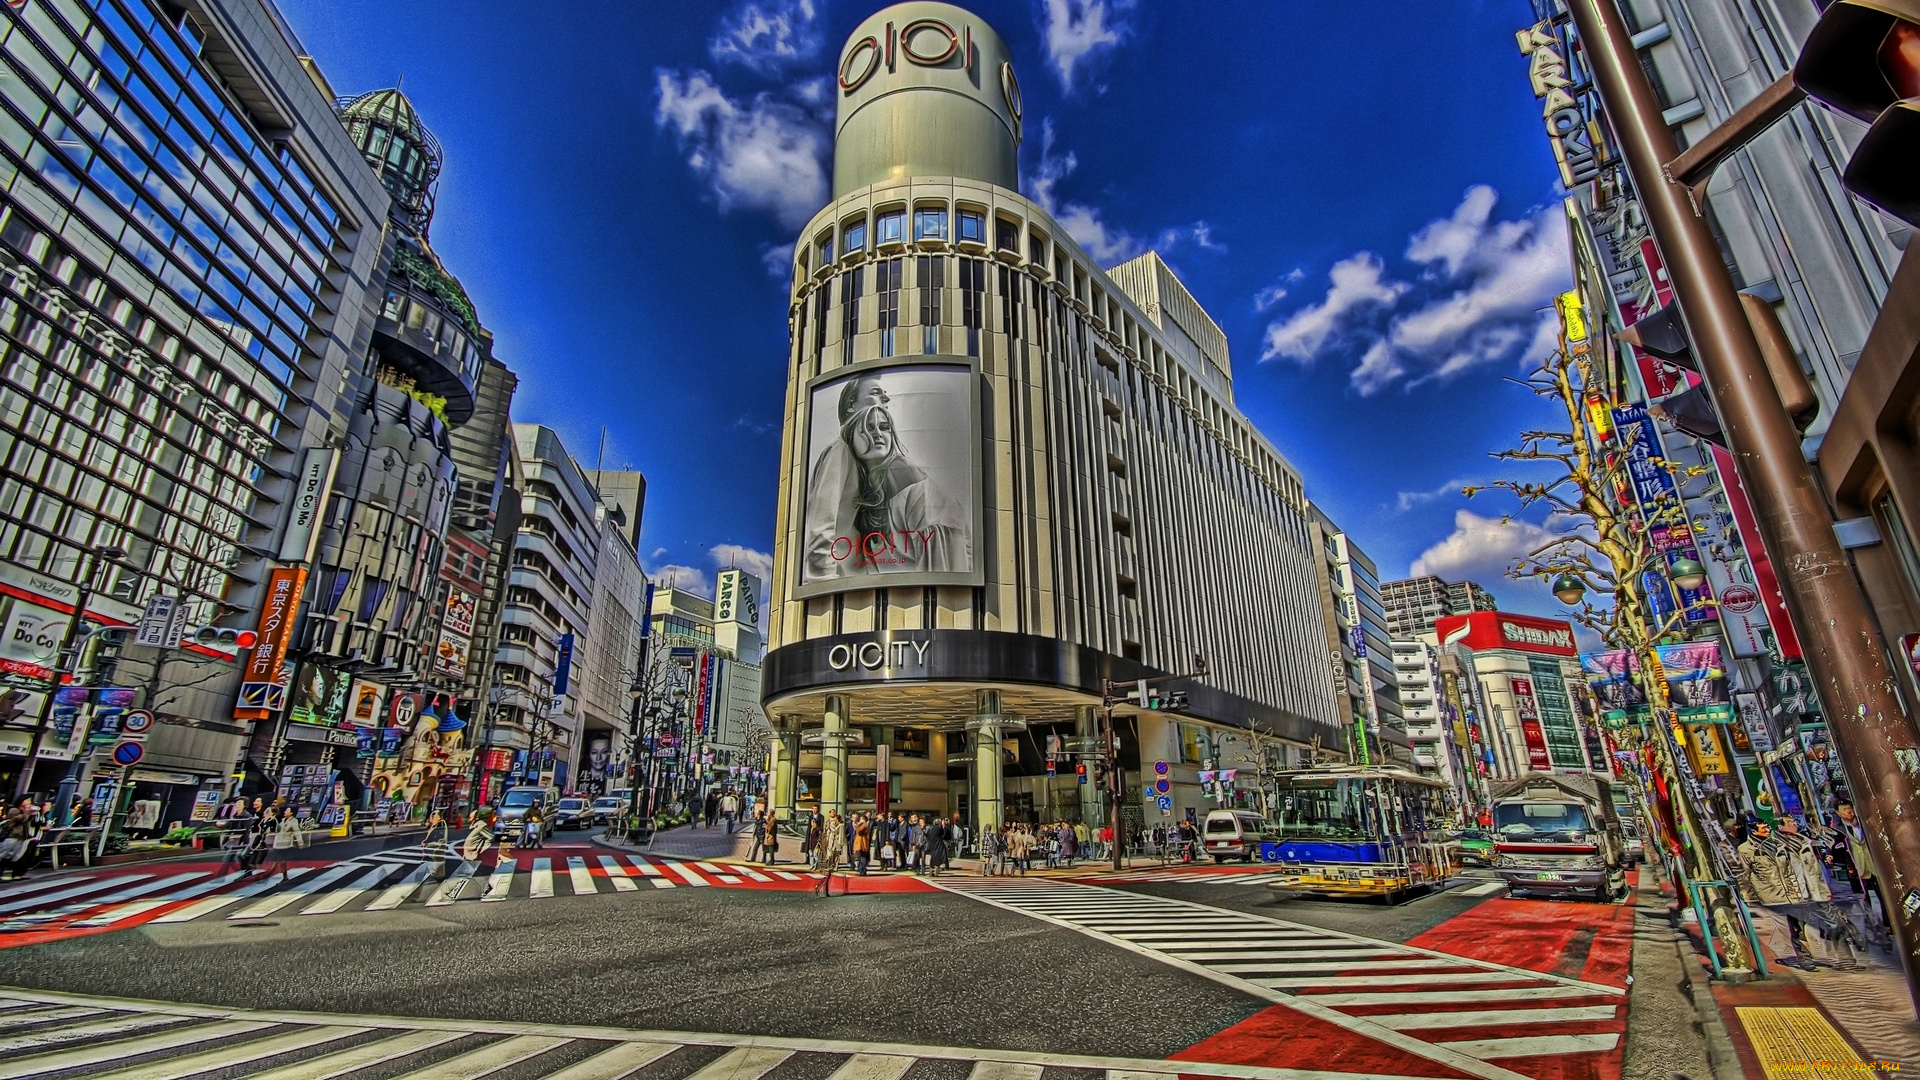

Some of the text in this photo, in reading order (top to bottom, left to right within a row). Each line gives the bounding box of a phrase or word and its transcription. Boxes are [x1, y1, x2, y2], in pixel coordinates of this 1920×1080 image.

[307, 479, 319, 492] Do
[302, 494, 314, 508] Co
[297, 511, 310, 526] Mo
[719, 574, 734, 619] PARCO
[740, 577, 759, 624] PARCO
[252, 579, 292, 674] 東京スター銀行
[272, 580, 303, 675] TOKYO STAR BANK
[1502, 621, 1574, 649] SHIDAX
[13, 628, 54, 648] Do Co
[828, 640, 931, 670] OICITY
[554, 700, 562, 710] P
[128, 716, 146, 728] 30
[329, 730, 357, 746] Pavilio
[513, 762, 521, 771] P
